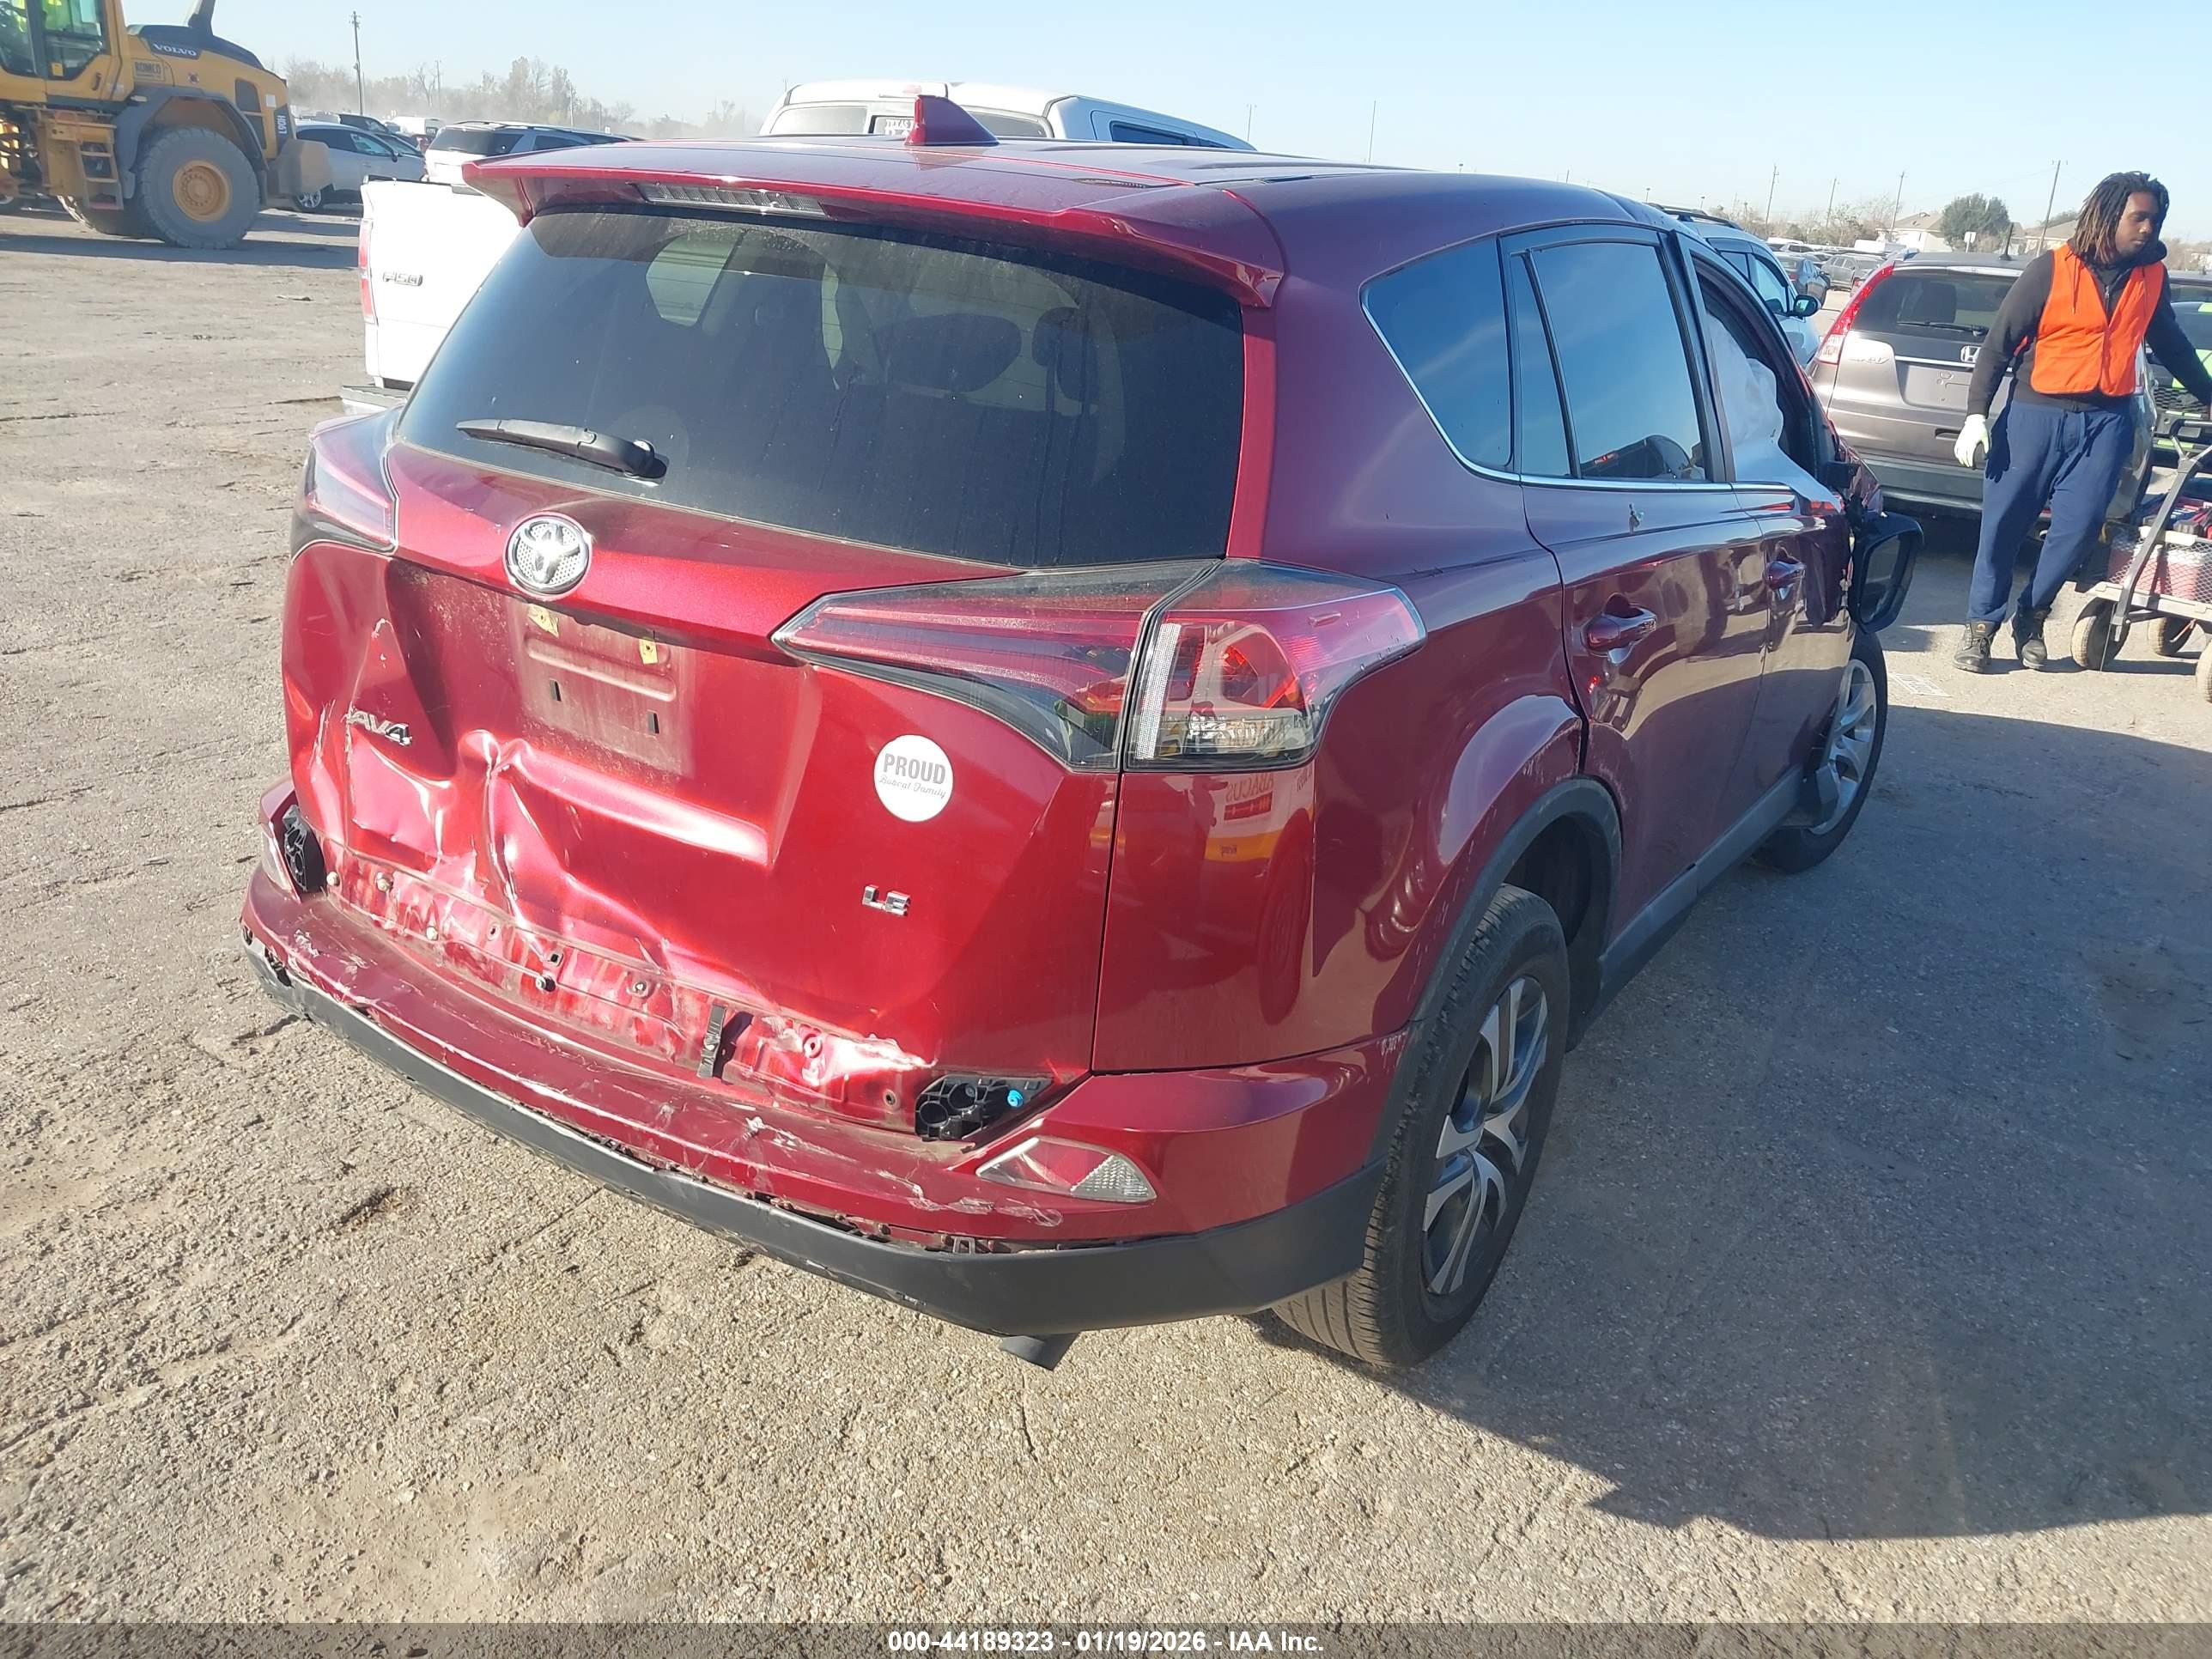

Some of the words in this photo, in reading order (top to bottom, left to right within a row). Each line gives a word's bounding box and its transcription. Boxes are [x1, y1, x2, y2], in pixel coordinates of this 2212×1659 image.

[153, 43, 198, 57] VOLVO
[276, 114, 288, 134] L90H
[883, 752, 946, 785] PROUD
[913, 782, 946, 799] Family
[861, 884, 910, 916] LE
